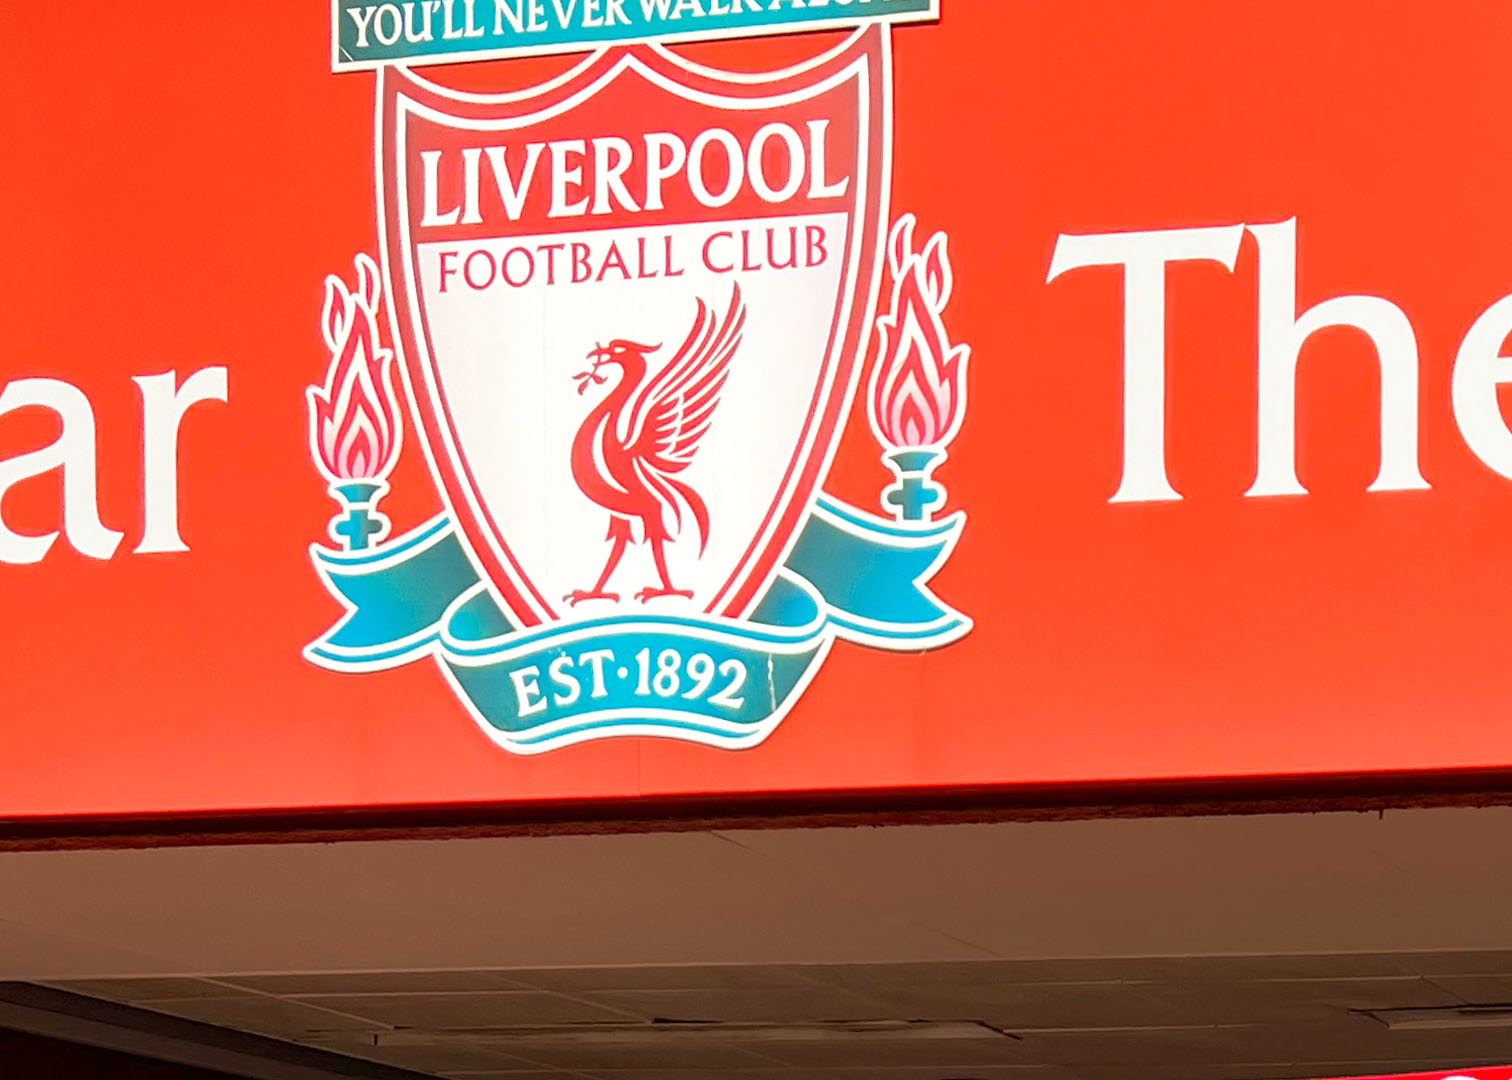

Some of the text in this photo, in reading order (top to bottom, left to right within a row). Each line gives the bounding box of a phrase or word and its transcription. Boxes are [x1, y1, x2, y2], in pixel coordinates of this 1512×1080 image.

[346, 0, 485, 47] YOU'LL
[493, 0, 632, 34] NEVER
[419, 119, 850, 229] LIVERPOOL
[438, 225, 830, 293] FOOTBALL CLUB
